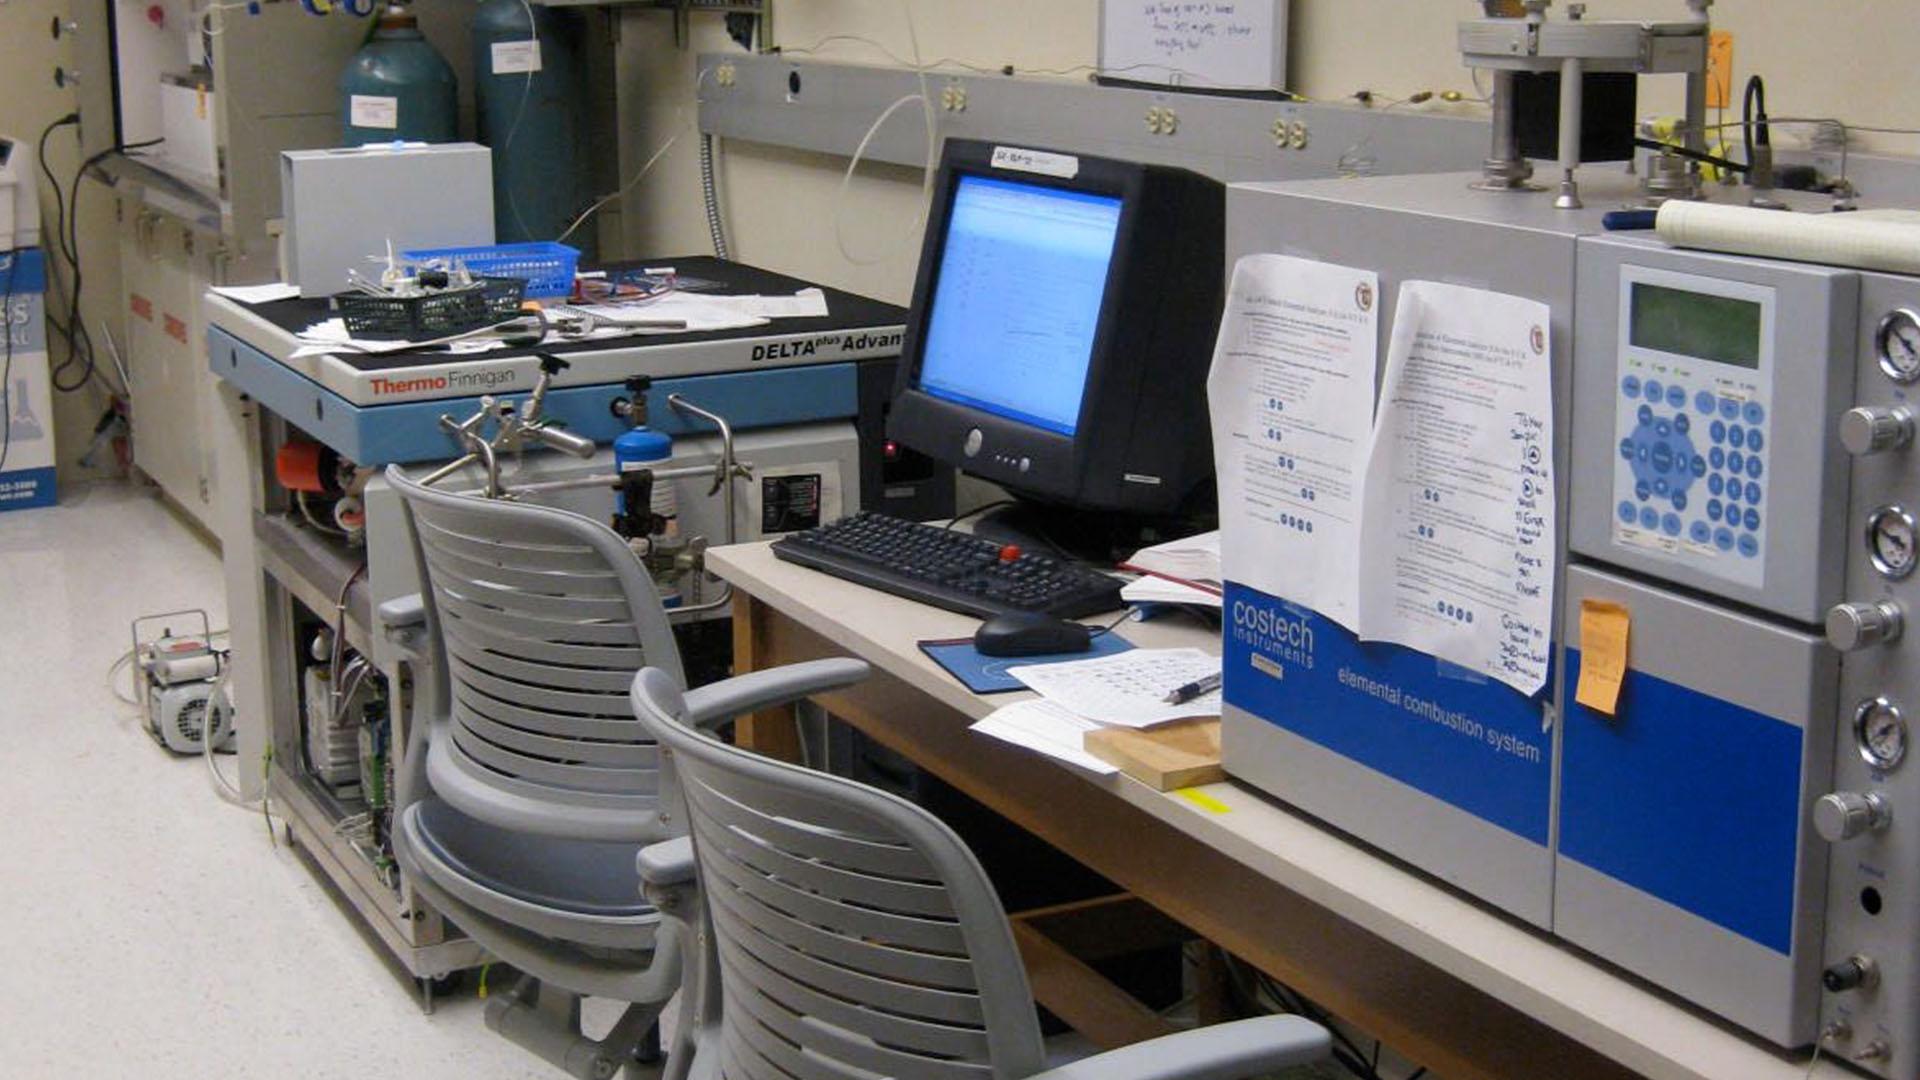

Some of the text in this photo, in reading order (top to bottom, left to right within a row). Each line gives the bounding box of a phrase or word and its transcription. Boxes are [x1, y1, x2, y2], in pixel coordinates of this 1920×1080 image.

[842, 333, 906, 351] Advan
[1233, 600, 1313, 653] costech
[1233, 625, 1313, 669] instruments
[1338, 666, 1541, 763] elemental combustion system
